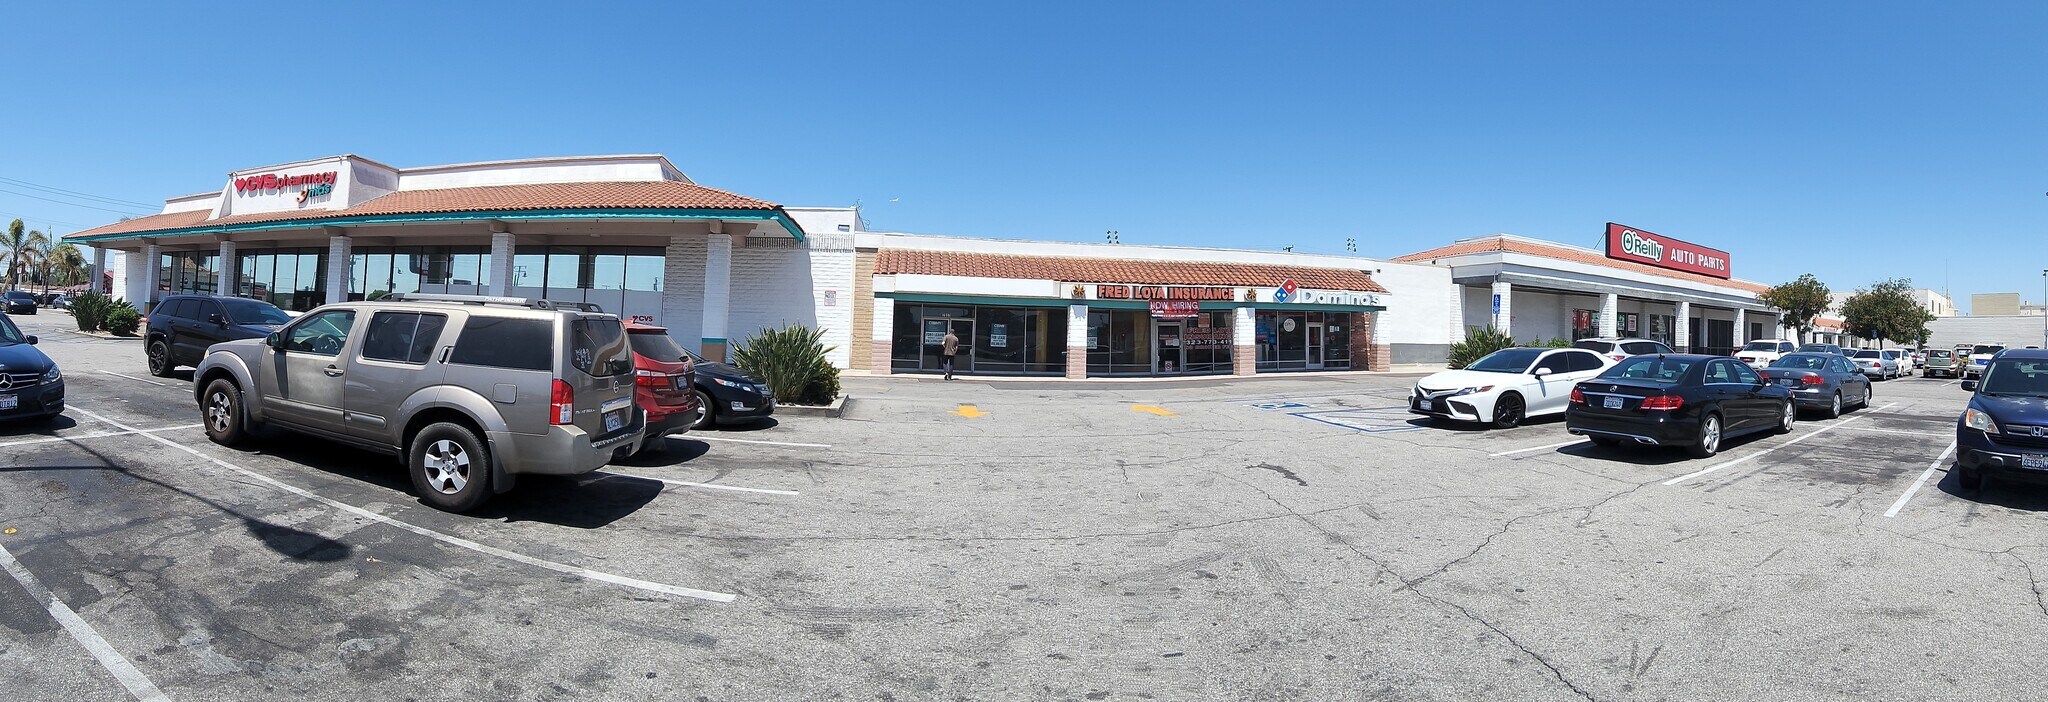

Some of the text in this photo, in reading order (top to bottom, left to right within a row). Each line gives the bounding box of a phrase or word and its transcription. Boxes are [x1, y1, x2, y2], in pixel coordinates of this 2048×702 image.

[246, 171, 338, 191] CVS pharmacy
[1622, 230, 1662, 261] O'Reilly
[1671, 248, 1694, 265] AUTO
[1098, 285, 1235, 300] FRED LOYA INSURANCE
[1301, 289, 1381, 305] Domino's
[1150, 301, 1198, 310] NOW HIRING
